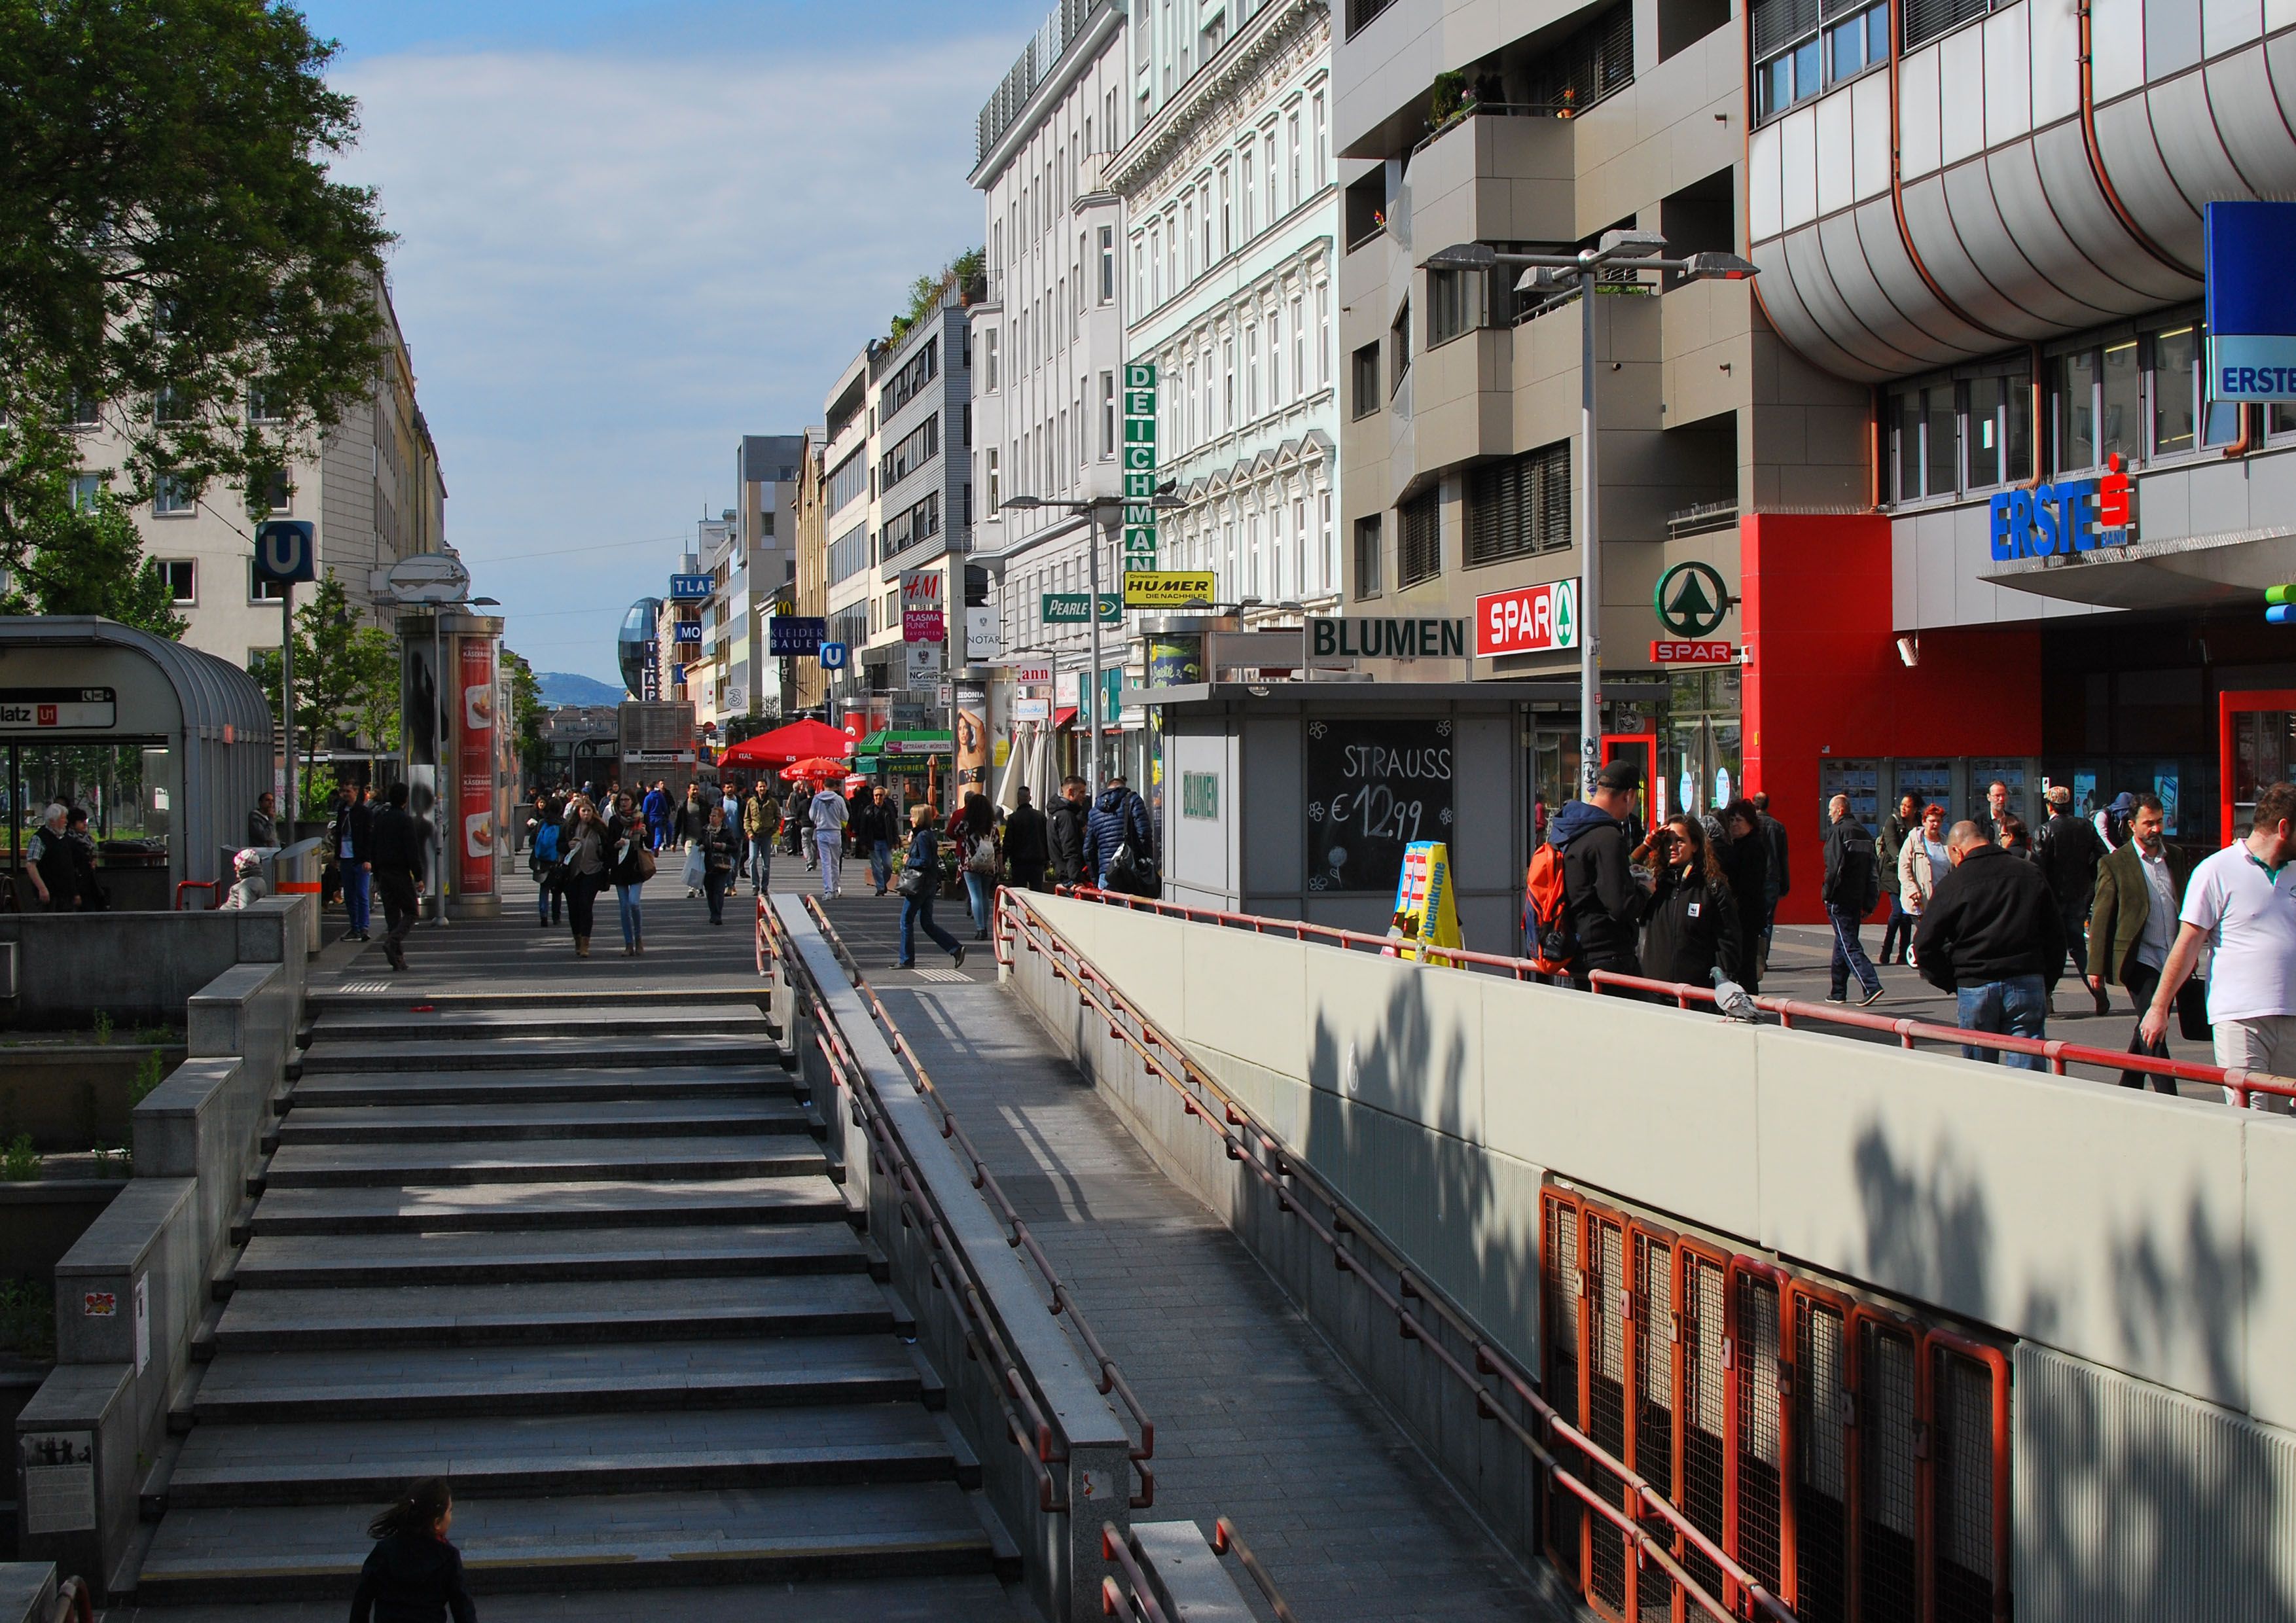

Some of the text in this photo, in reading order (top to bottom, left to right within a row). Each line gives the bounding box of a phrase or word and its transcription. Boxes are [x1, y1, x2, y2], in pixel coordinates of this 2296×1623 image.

[1990, 478, 2095, 561] ERSTE
[2102, 528, 2127, 547] BANK
[266, 535, 300, 575] U
[903, 575, 938, 599] H&M
[1128, 581, 1209, 591] HUMER
[1049, 599, 1088, 616] PEARLE
[1490, 595, 1550, 645] SPAR
[770, 628, 824, 637] KLEIDER
[967, 635, 1000, 644] NOTAR
[1314, 620, 1463, 656] BLUMEN
[826, 649, 842, 666] U
[1658, 644, 1728, 659] SPAR
[0, 705, 54, 722] latz U1
[1343, 745, 1451, 779] STRAUSS
[1183, 775, 1218, 819] BLUMEN
[1331, 784, 1422, 842] € 12.99
[1424, 862, 1446, 938] Abendkrone
